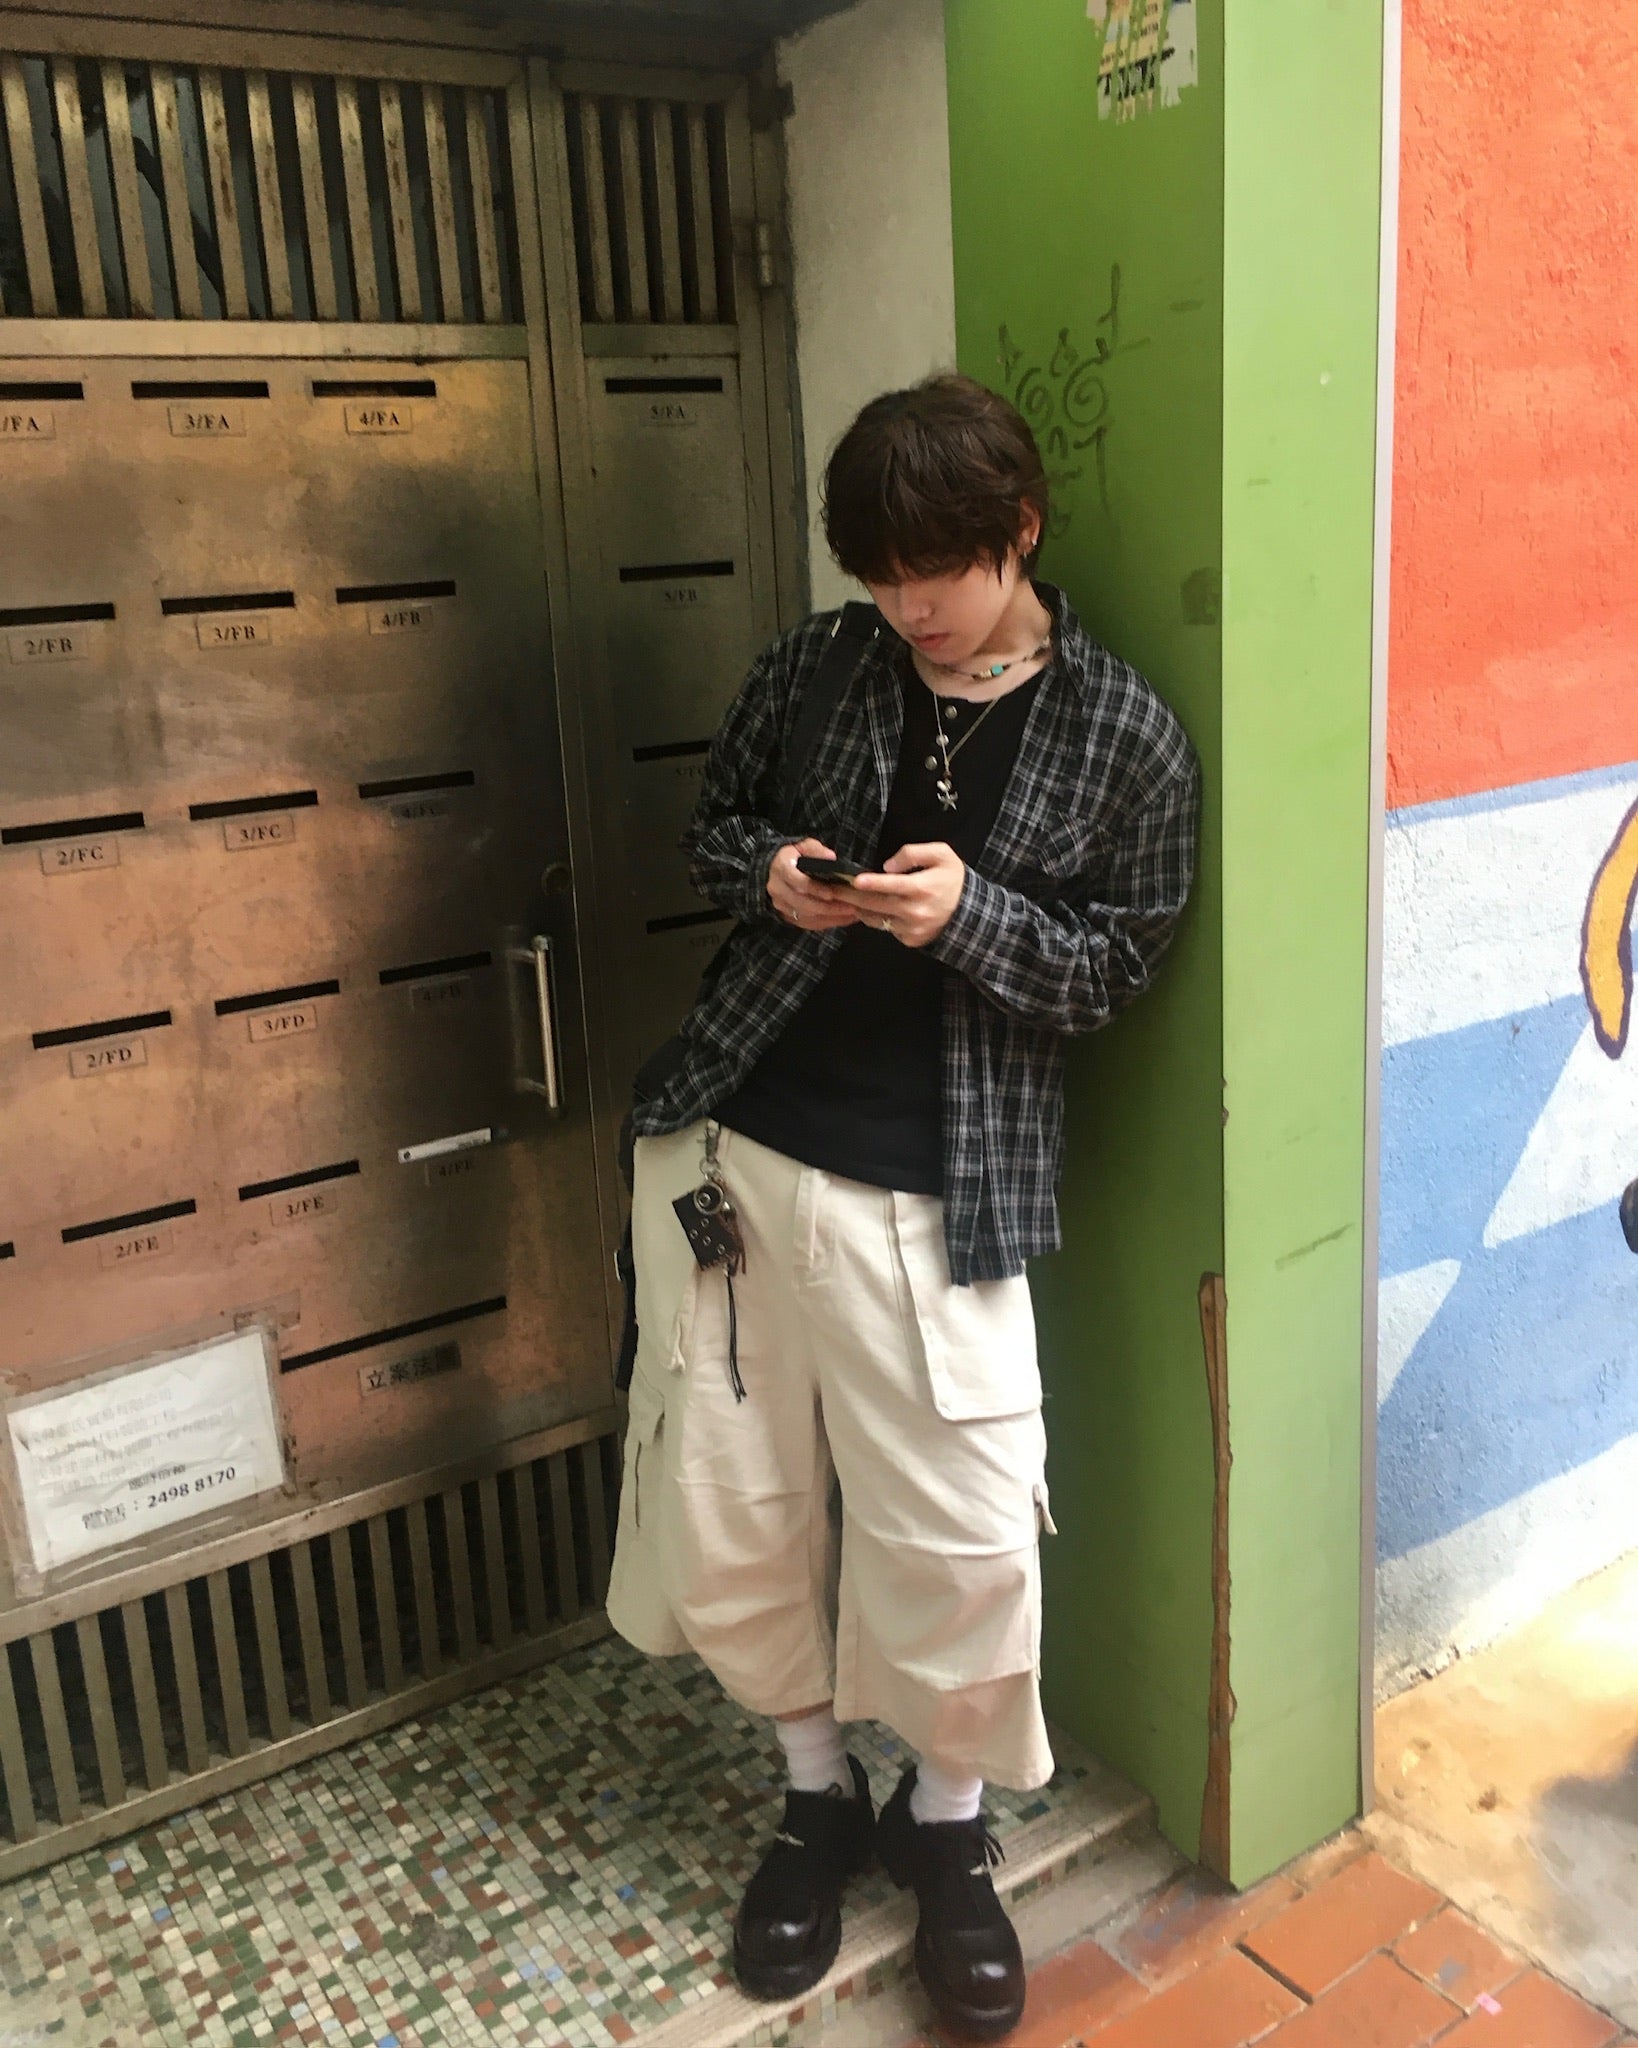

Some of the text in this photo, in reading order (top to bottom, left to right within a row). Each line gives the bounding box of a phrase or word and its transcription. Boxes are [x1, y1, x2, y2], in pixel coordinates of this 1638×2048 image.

[2, 414, 41, 432] /FA
[184, 413, 230, 431] 3/FA
[359, 411, 400, 427] 4/FA
[382, 610, 421, 627] 4/FB
[213, 625, 256, 643] 3/FB
[24, 638, 73, 656] 2/FB
[240, 824, 282, 843] 3/FC
[57, 846, 104, 866] 2/FC
[264, 1014, 306, 1034] 3/FD
[86, 1048, 132, 1068] 2/FD
[286, 1196, 326, 1218] 3/FE
[116, 1236, 160, 1258] 2/FE
[148, 1482, 189, 1508] 2498
[195, 1466, 236, 1493] 8170
